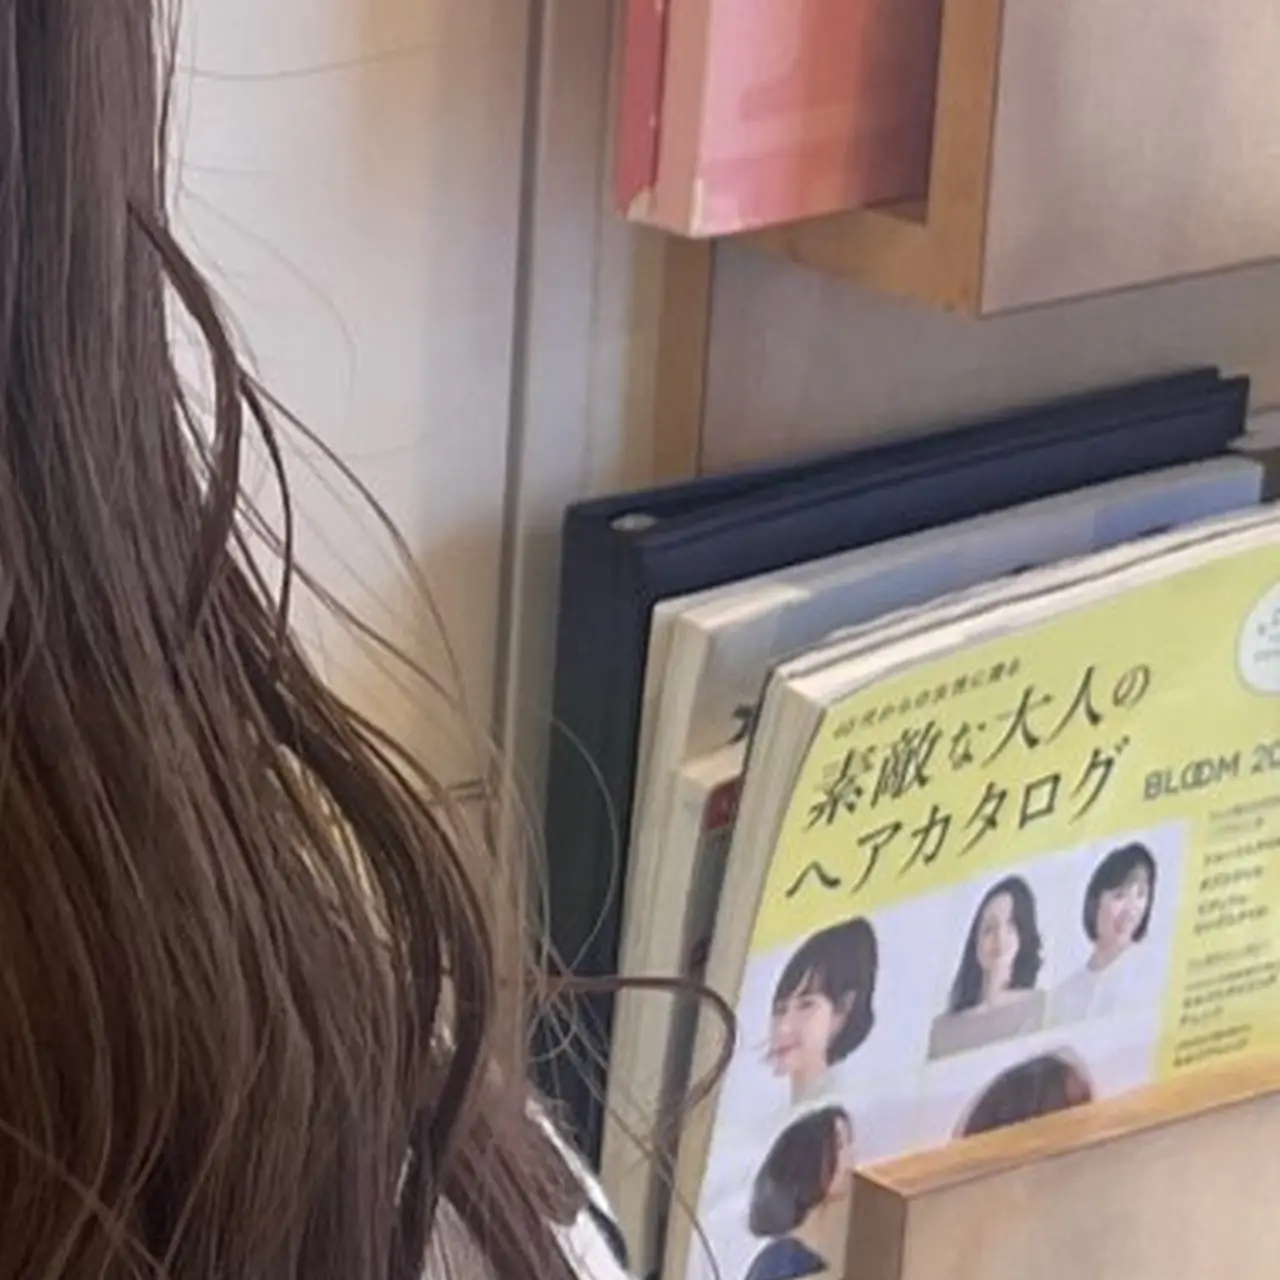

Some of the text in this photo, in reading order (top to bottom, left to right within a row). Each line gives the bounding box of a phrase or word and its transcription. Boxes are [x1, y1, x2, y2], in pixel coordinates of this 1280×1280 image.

[785, 735, 1131, 899] ヘアカタログ
[805, 664, 1150, 832] 素敵な大人の
